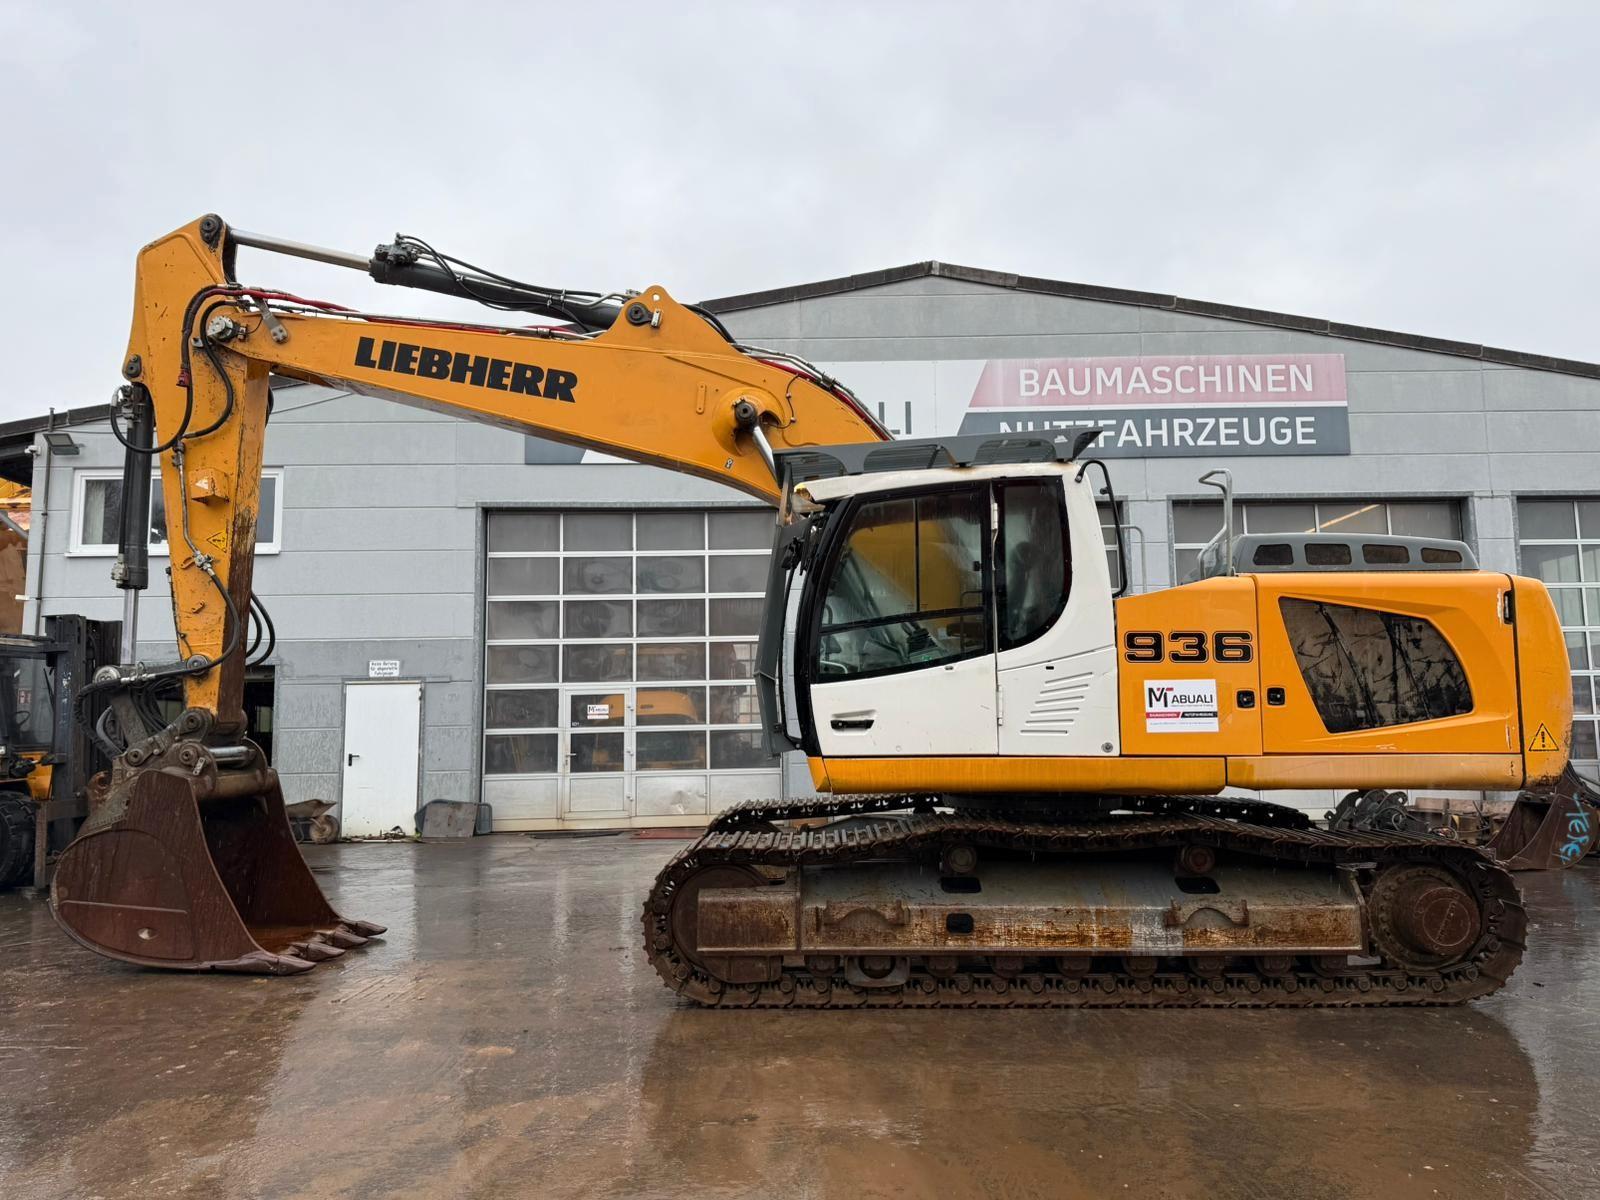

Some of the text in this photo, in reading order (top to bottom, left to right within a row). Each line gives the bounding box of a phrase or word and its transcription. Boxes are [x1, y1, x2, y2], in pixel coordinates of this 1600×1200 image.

[354, 336, 578, 403] LIEBHERR
[1019, 363, 1314, 397] BAUMASCHINEN
[1000, 416, 1317, 447] FAHRZEUGE
[1124, 630, 1253, 663] 936
[1171, 694, 1213, 704] ABUALI
